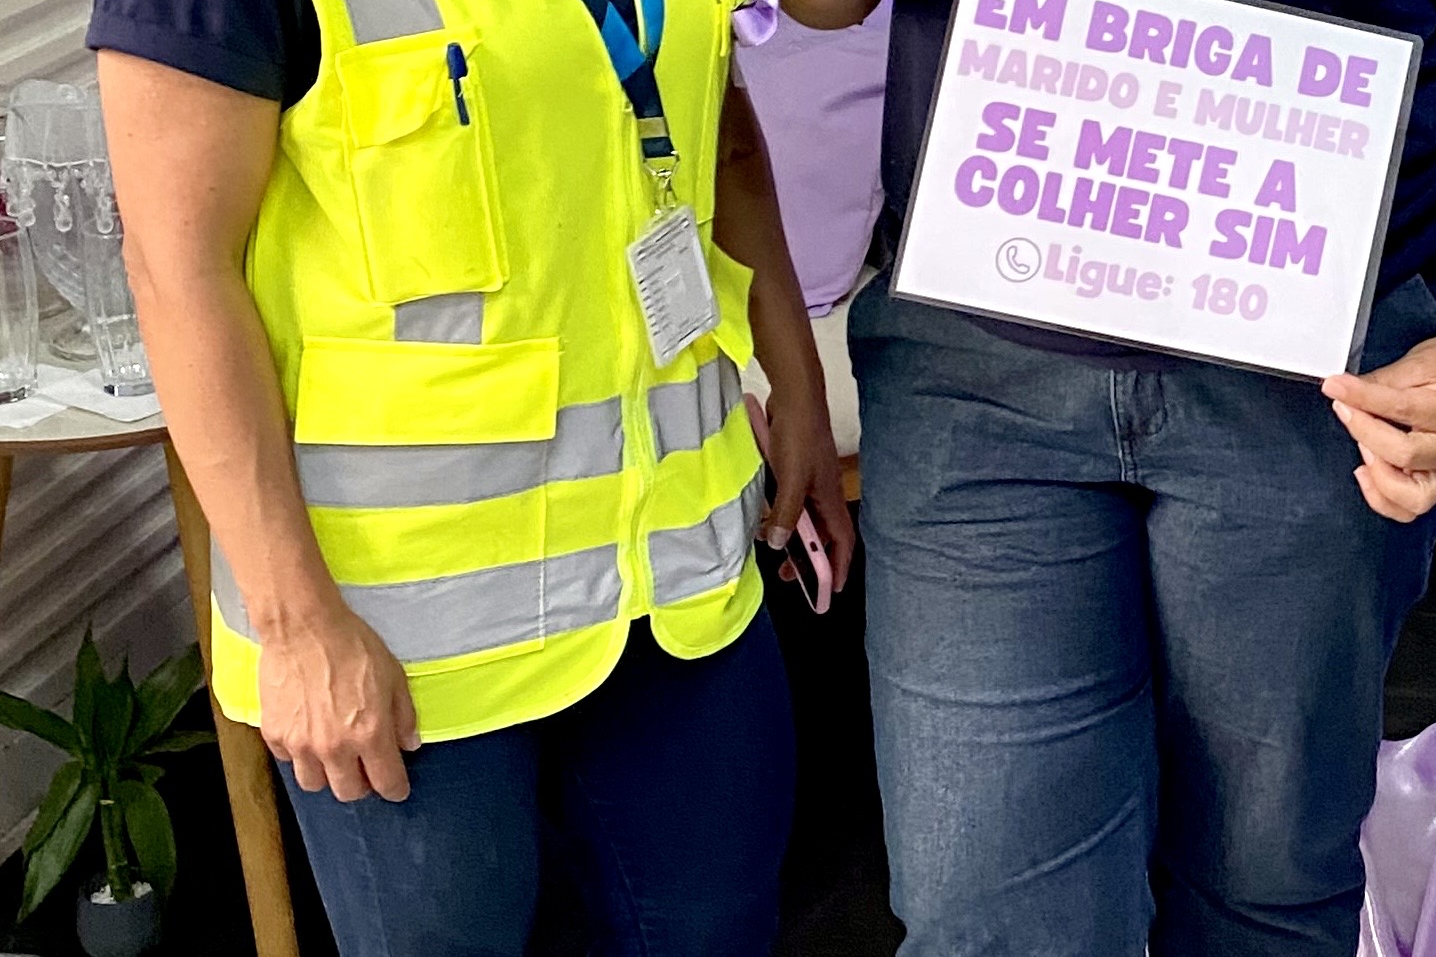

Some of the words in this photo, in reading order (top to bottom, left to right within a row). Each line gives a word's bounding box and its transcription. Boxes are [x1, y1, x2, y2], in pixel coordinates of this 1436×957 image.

[957, 38, 1140, 109] MARIDO
[1153, 81, 1183, 118] E
[1193, 88, 1370, 160] MULHER
[1085, 0, 1273, 87] BRIGA
[1297, 46, 1378, 108] DE
[976, 101, 1057, 161] SE
[1073, 119, 1238, 199] METE
[1254, 159, 1297, 213] A
[954, 154, 1190, 249] COLHER
[1208, 208, 1328, 276] SIM
[1043, 243, 1175, 299] Ligue:
[1191, 273, 1269, 322] 180
